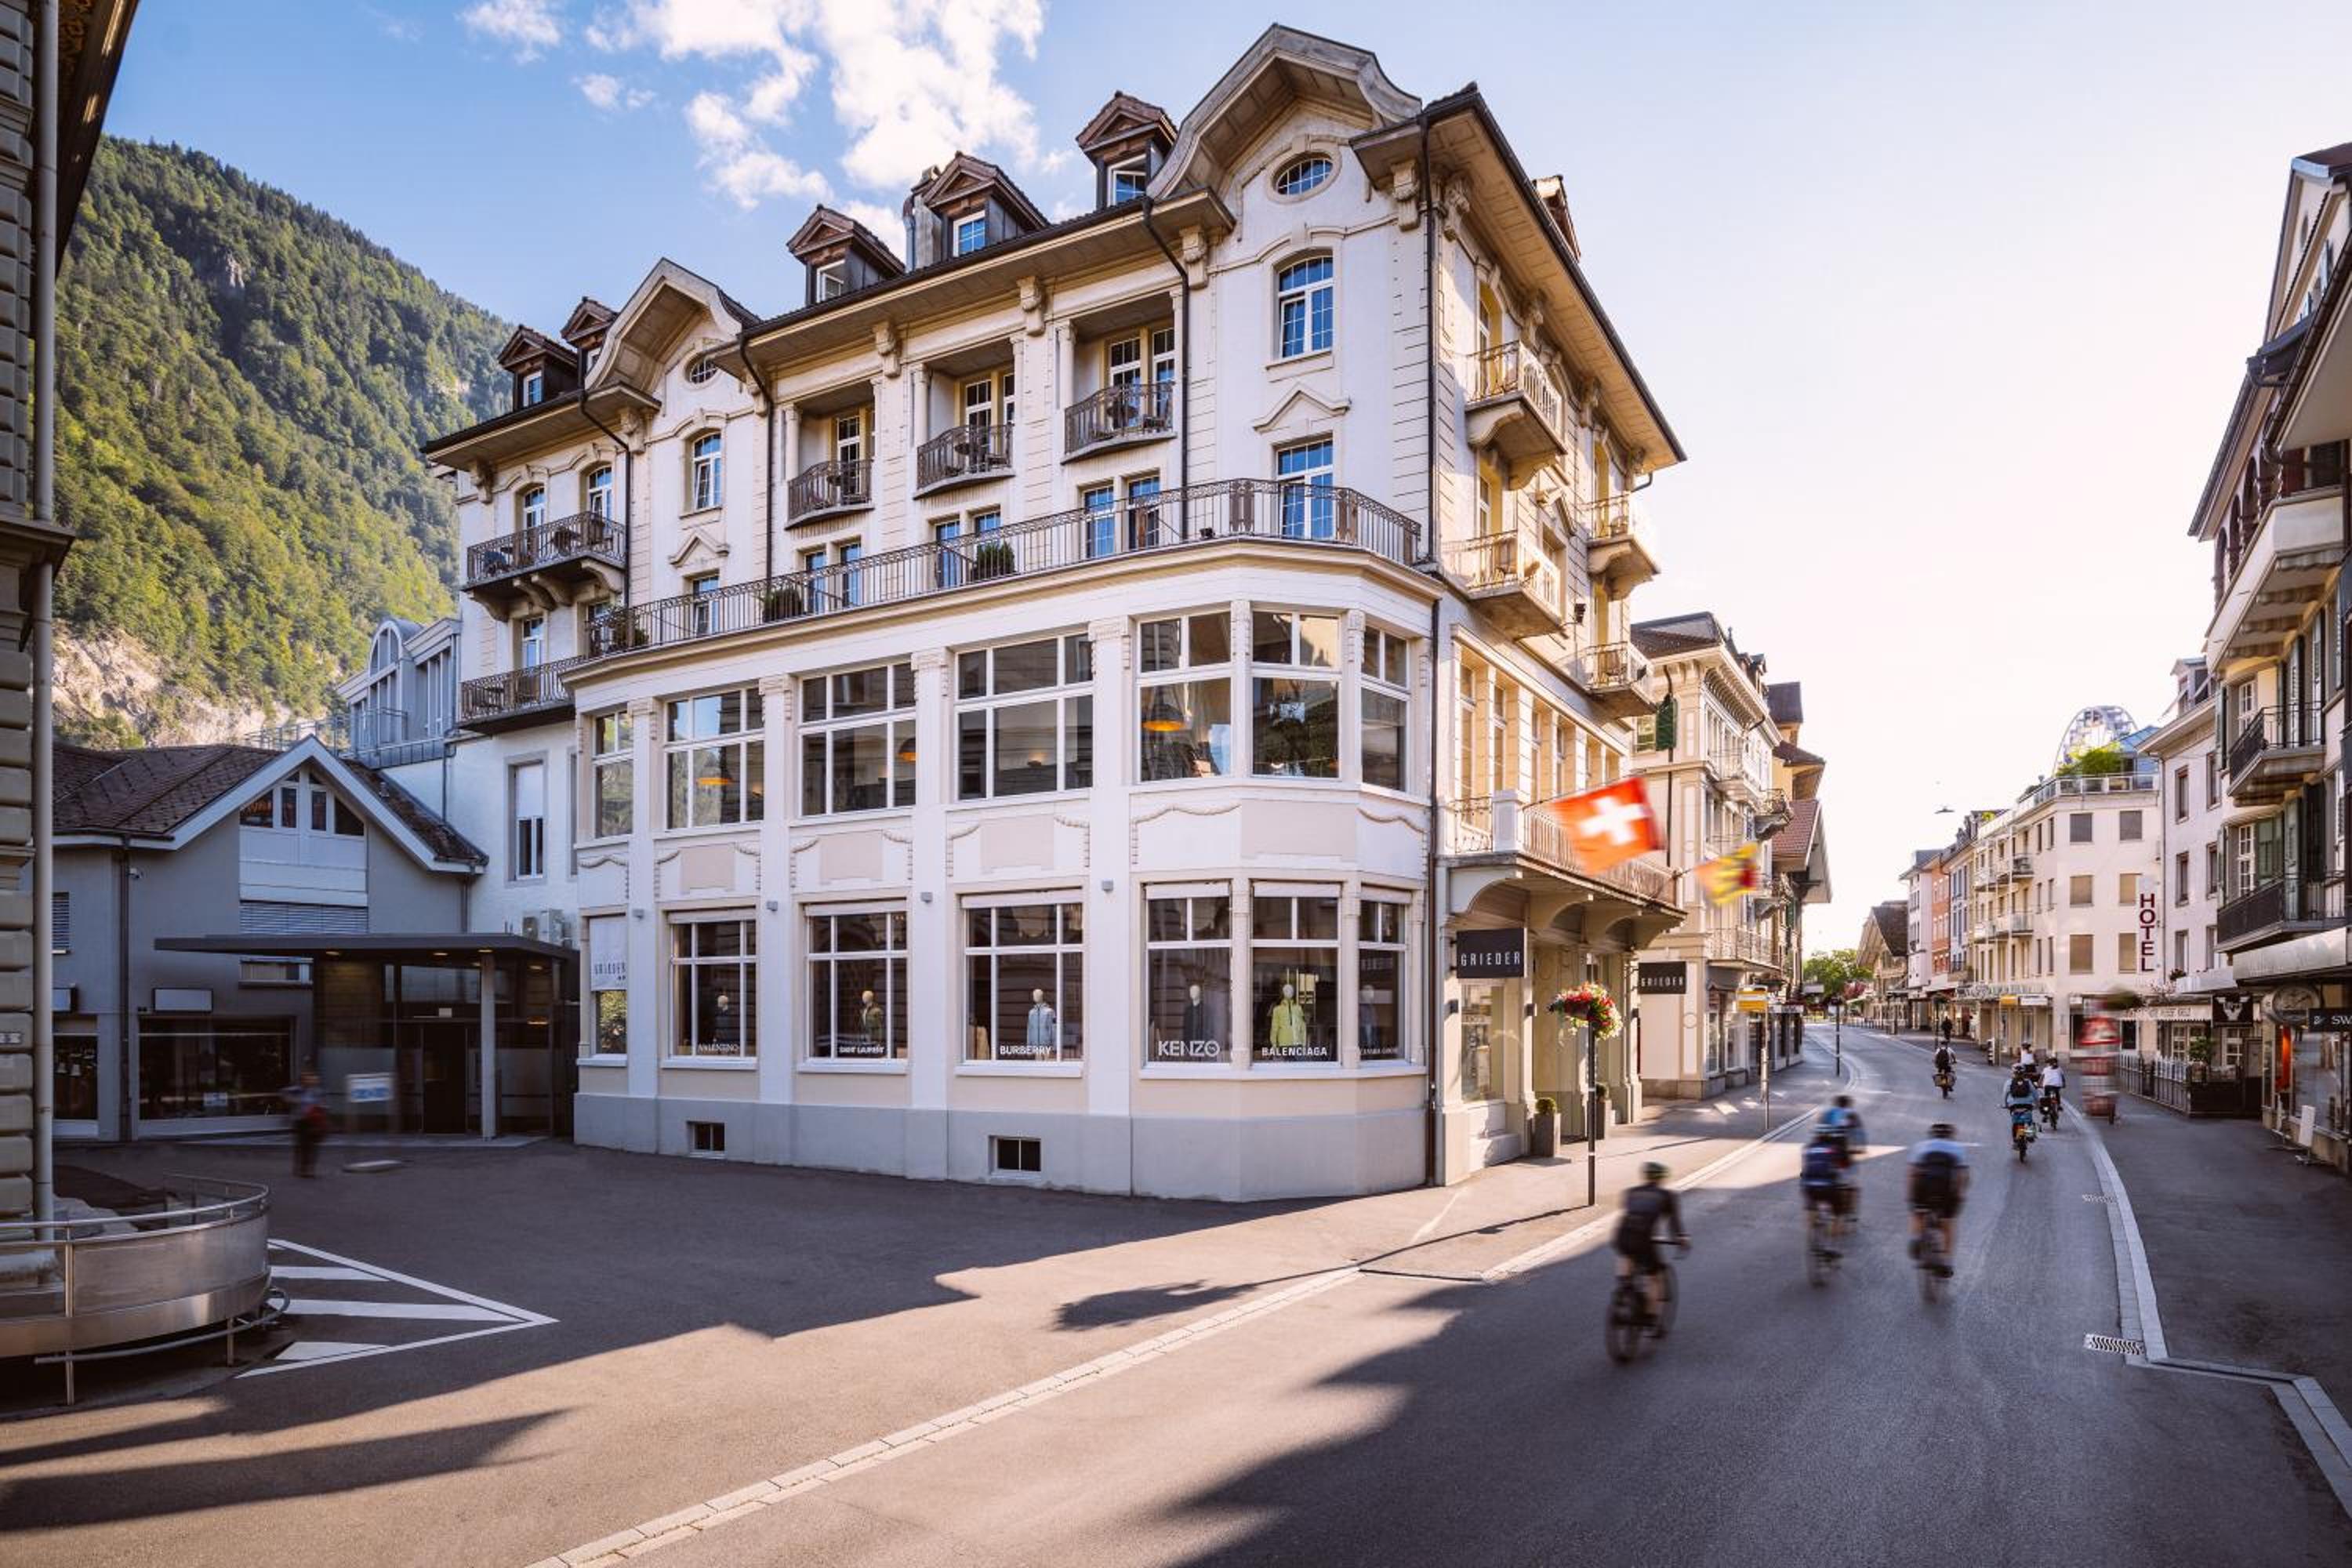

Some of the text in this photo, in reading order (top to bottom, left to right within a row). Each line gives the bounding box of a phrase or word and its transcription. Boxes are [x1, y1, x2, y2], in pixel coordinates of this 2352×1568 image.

[2140, 893, 2155, 971] HOTEL
[1461, 952, 1520, 966] GRIEDER
[1641, 976, 1683, 986] GRIEDER
[2332, 1015, 2352, 1025] SW
[1000, 1045, 1053, 1054] BURBERRY
[1158, 1040, 1221, 1057] KENZO
[1261, 1047, 1328, 1056] BALENCIAGA
